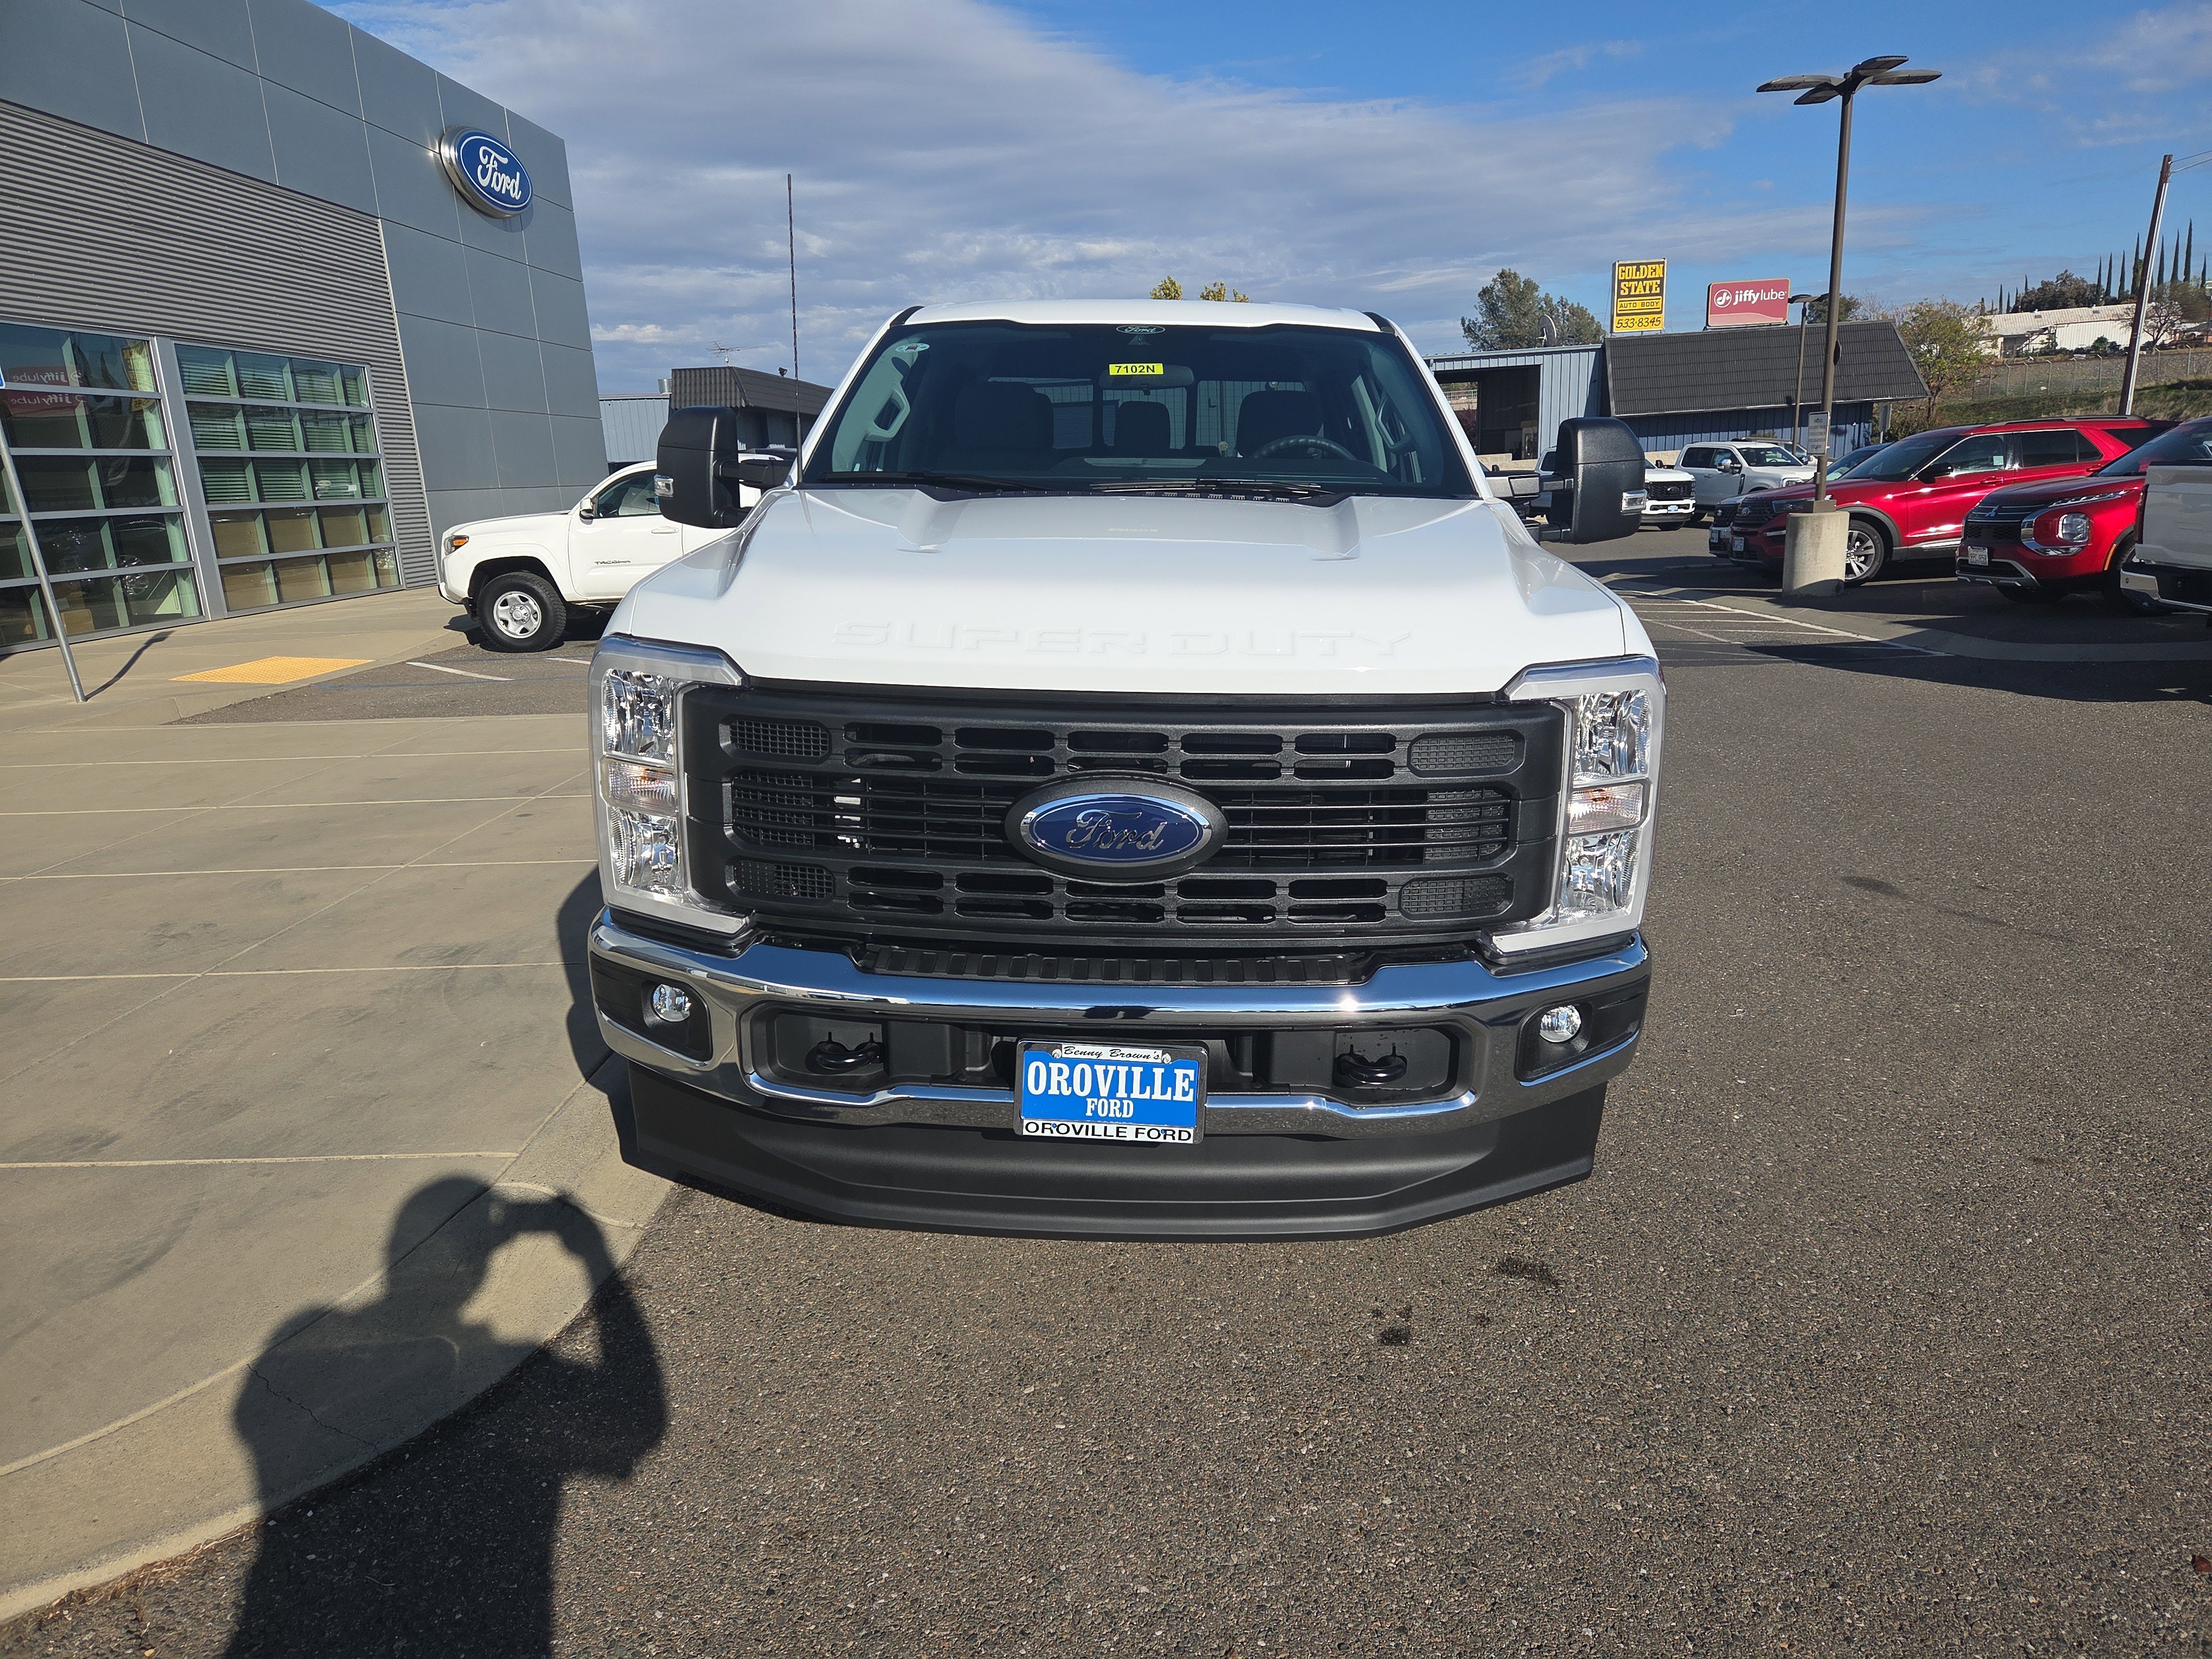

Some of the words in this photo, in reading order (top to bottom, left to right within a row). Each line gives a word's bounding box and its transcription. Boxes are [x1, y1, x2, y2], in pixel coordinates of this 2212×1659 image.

[477, 146, 522, 200] Ford
[1618, 264, 1664, 279] GOLDEN
[1620, 279, 1661, 295] STATE
[1115, 365, 1155, 374] 7102N
[832, 619, 1148, 656] SUPER
[1168, 628, 1413, 658] DUTY
[1066, 808, 1167, 851] Ford
[1063, 1046, 1103, 1058] Benny
[1109, 1049, 1161, 1060] Brown's
[1027, 1060, 1195, 1102] OROVILLE
[1085, 1098, 1134, 1118] FORD
[1025, 1121, 1128, 1139] OROVILLE
[1135, 1128, 1192, 1141] FORD
